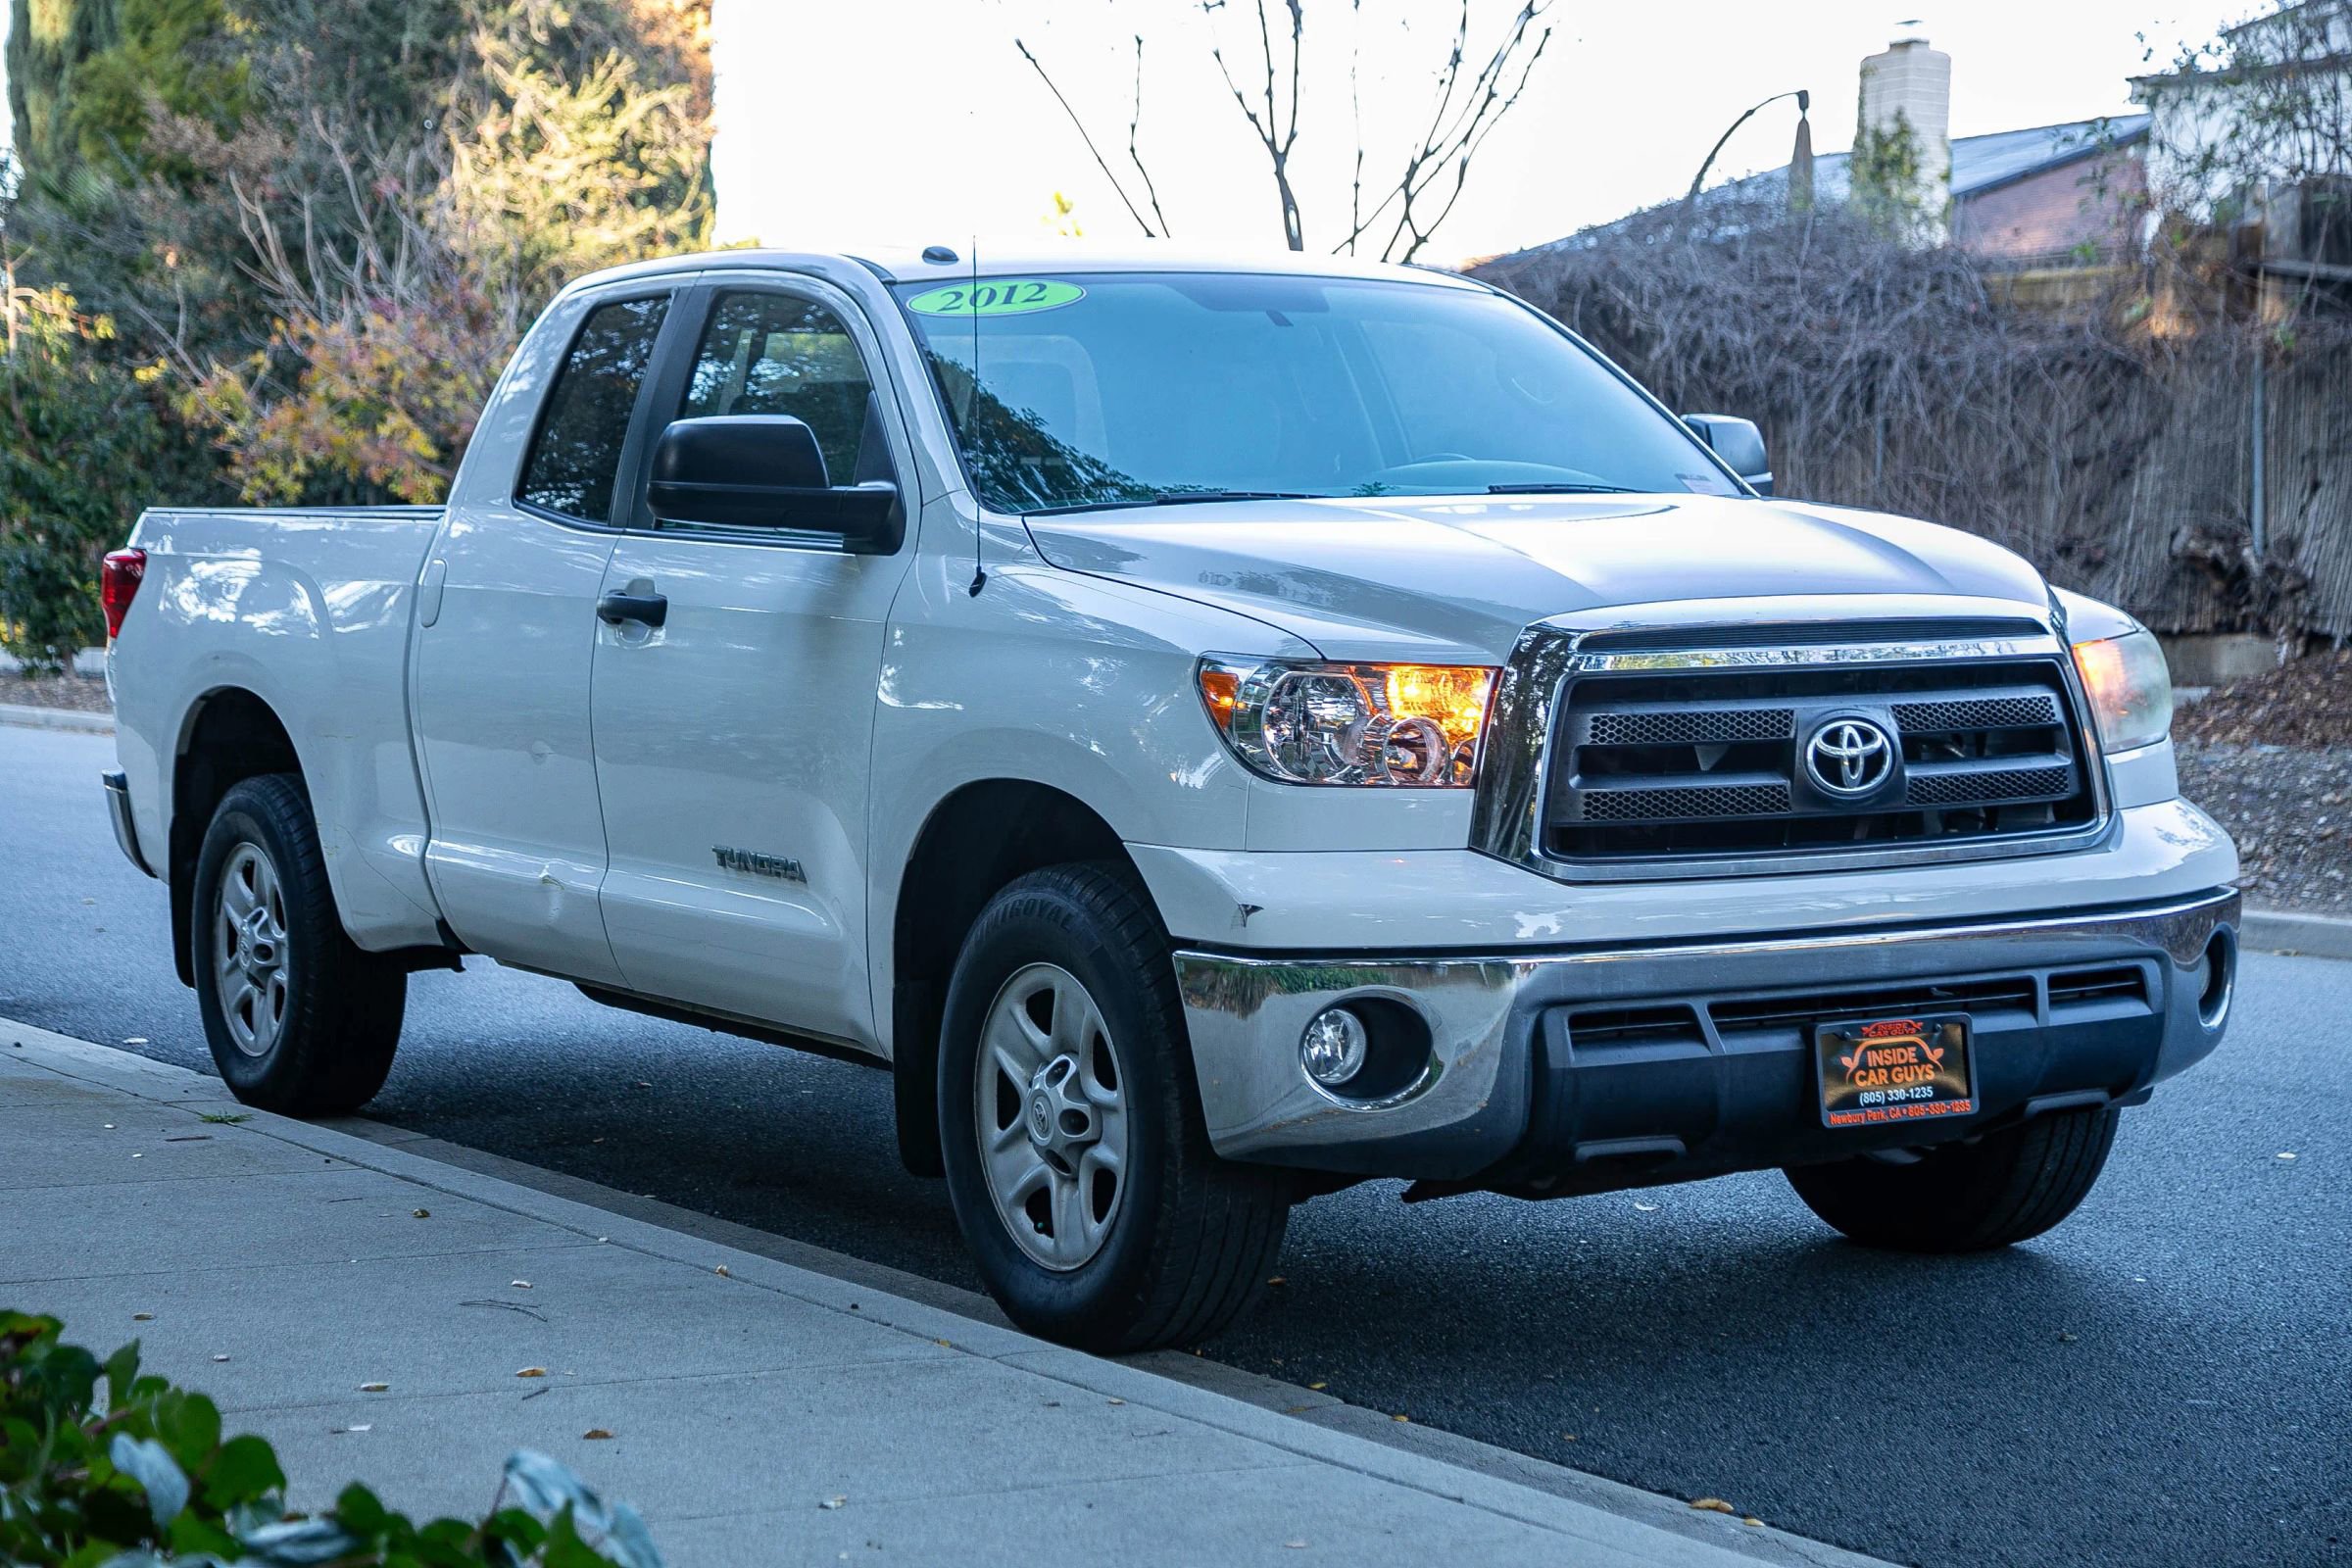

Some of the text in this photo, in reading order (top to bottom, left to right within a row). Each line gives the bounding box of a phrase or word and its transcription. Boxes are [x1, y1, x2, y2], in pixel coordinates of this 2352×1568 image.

[937, 282, 1048, 312] 2012
[711, 844, 808, 884] TUNDRA
[1867, 1047, 1918, 1067] INSIDE
[1854, 1064, 1936, 1087] CAR GUYS
[1859, 1086, 1934, 1106] (805) 330-1235
[1830, 1100, 1972, 1125] Newbury Park, CA 805-330-1235
